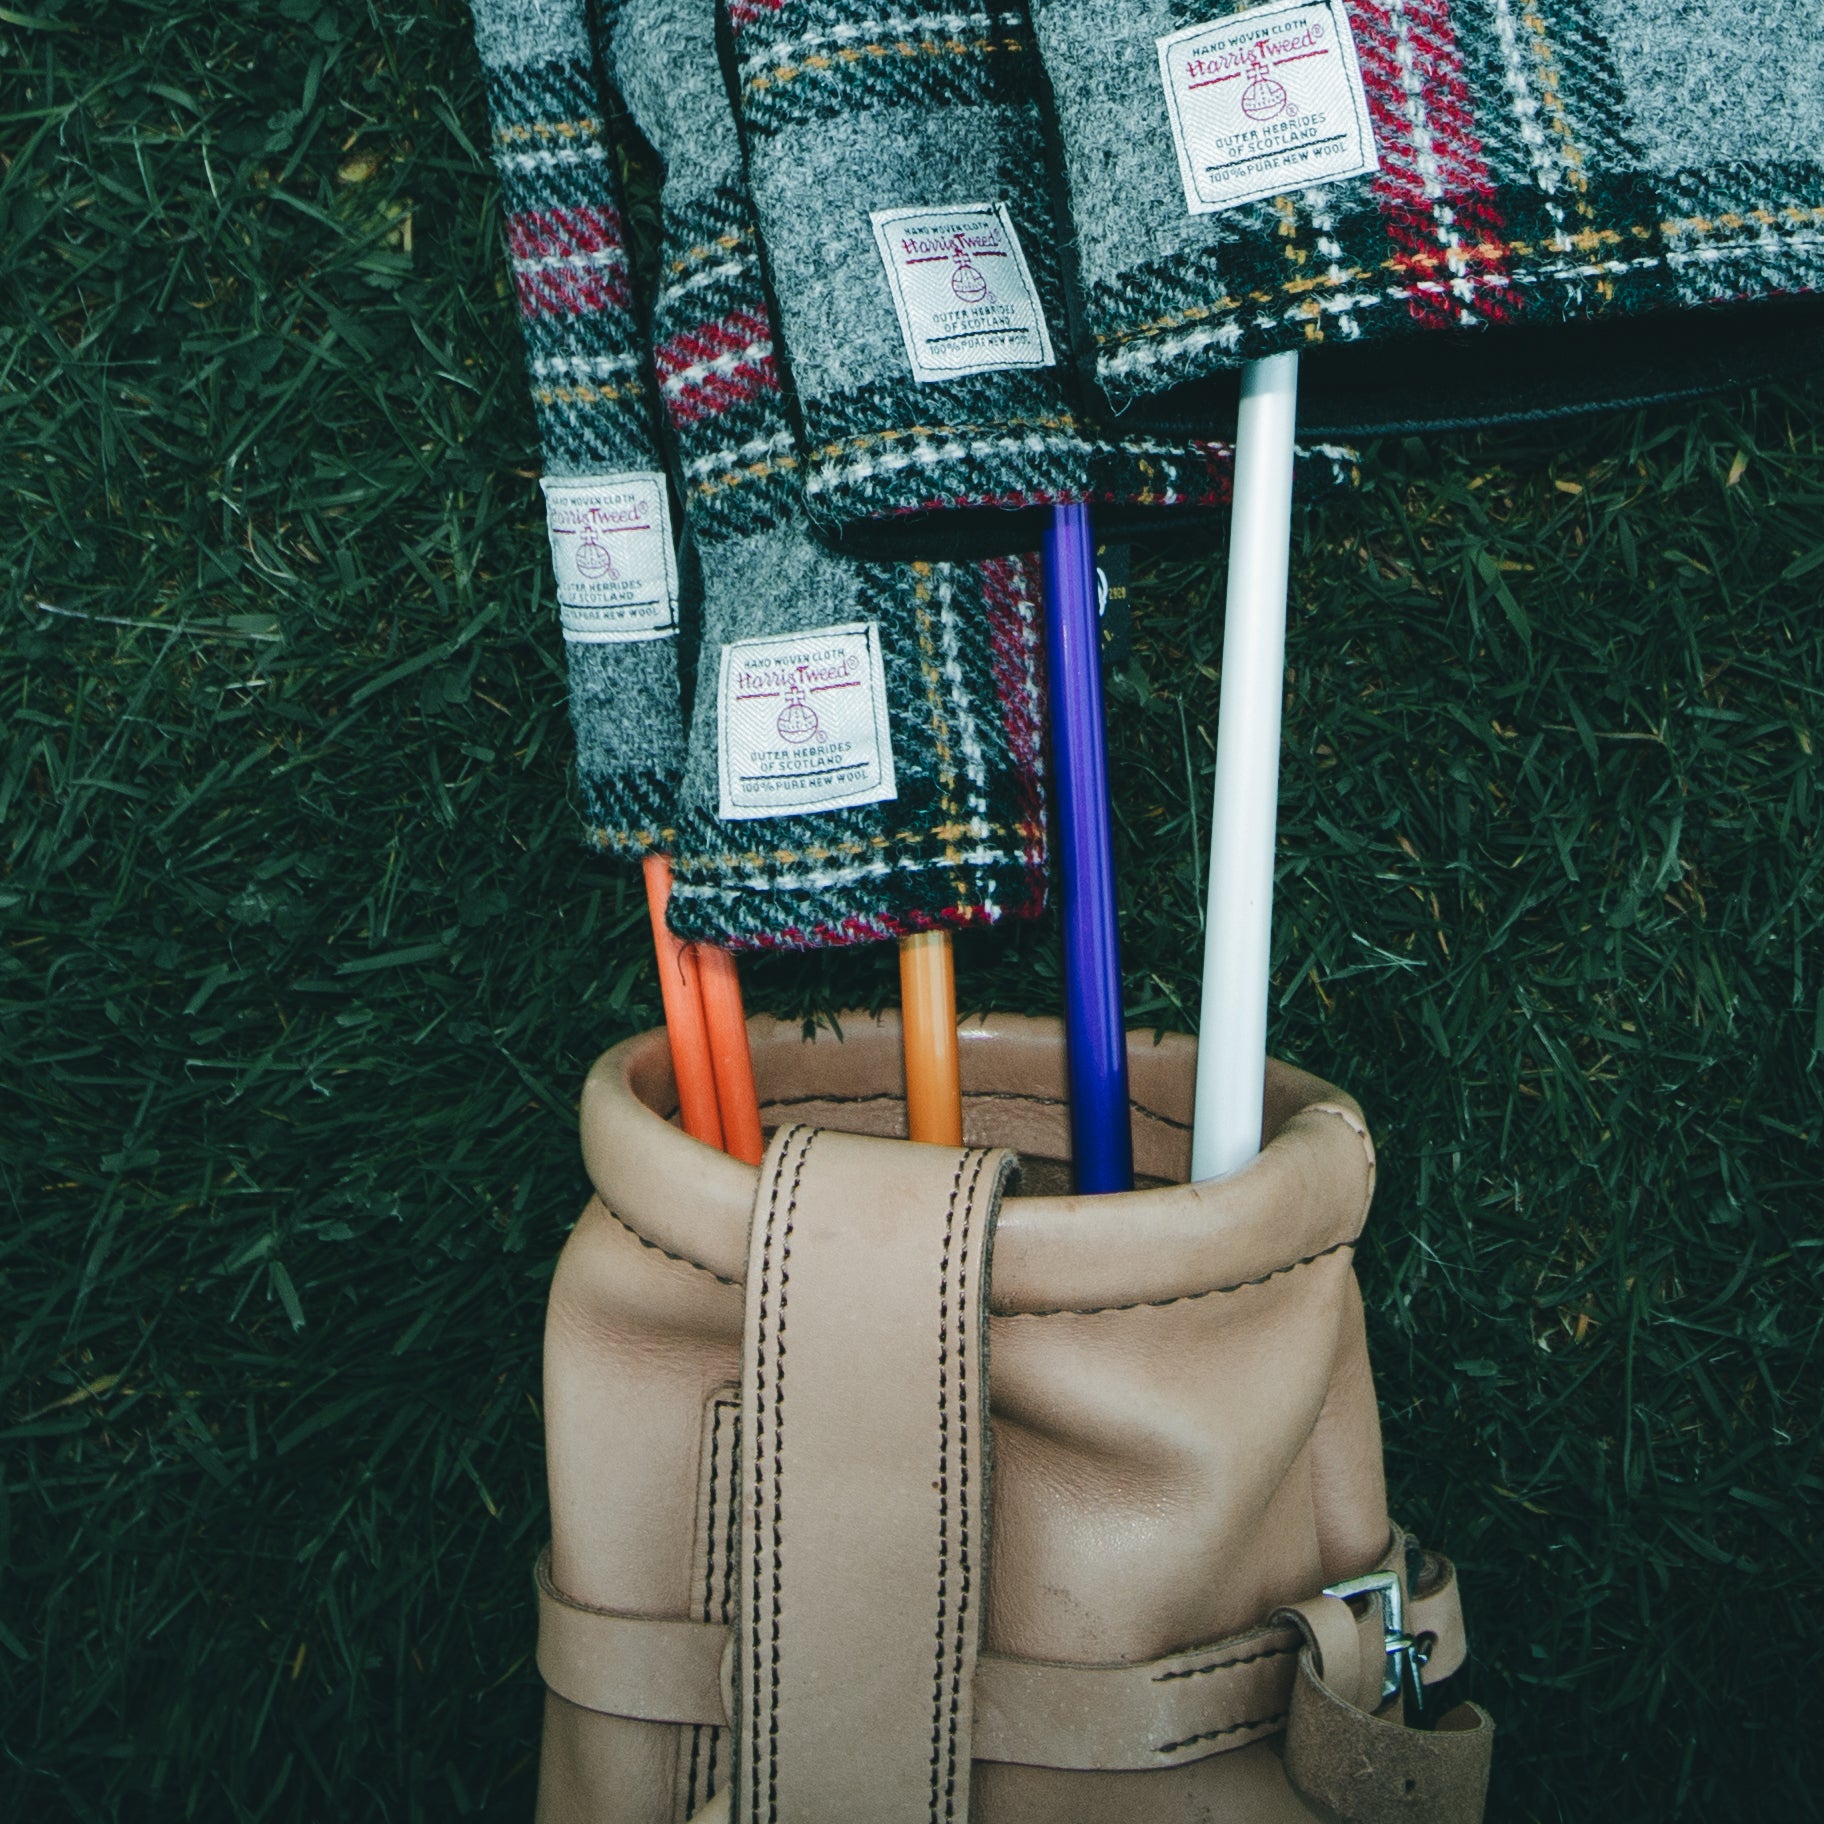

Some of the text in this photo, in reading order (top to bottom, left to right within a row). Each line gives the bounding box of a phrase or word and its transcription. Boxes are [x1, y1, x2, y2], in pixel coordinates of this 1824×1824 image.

[1193, 19, 1307, 56] HAND WOVEN CLOTH
[1186, 47, 1257, 77] Harris
[1216, 112, 1326, 148] OUTER HEBRIDES
[1229, 128, 1317, 157] OF SCOTLAND
[1210, 143, 1347, 184] 100% PURE NEW WOOL
[904, 222, 989, 234] HAND WOVEN CLOTH
[902, 236, 957, 254] Harris
[933, 304, 1015, 322] OUTER HEBRIDES
[945, 317, 1011, 332] OF SCOTLAND
[989, 336, 1004, 346] NEW
[603, 495, 635, 504] CLOTH
[589, 580, 642, 591] HEBRIDES
[579, 592, 634, 602] SCOTLAND
[603, 611, 624, 620] NEW
[629, 608, 658, 616] WOOL
[744, 649, 845, 668] HAND WOVEN CLOTH
[737, 669, 796, 689] Harris
[751, 742, 852, 761] OUTER HEBRIDES
[761, 755, 843, 772] OF SCOTLAND
[743, 771, 868, 793] 100% PURE NEW WOOL
